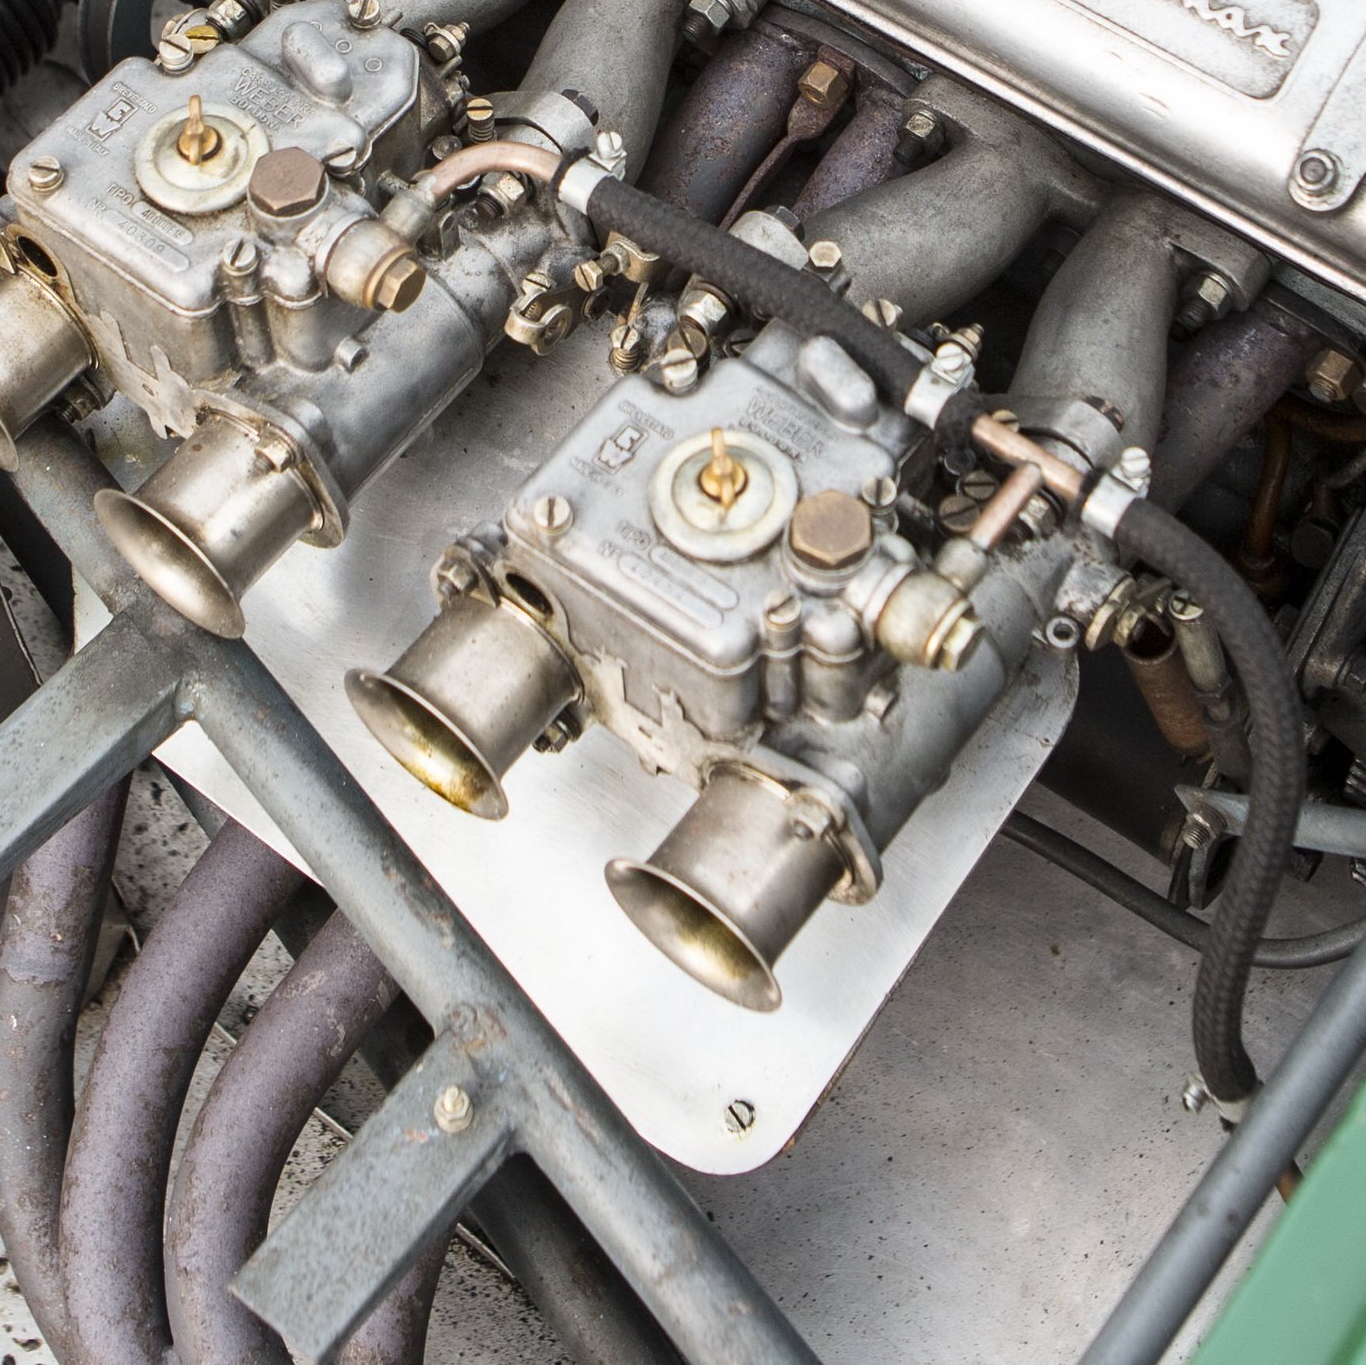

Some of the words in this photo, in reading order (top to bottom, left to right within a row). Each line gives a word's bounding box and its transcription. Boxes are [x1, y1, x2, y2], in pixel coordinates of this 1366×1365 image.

[233, 75, 307, 129] WEBER
[105, 182, 135, 205] TIPO
[745, 395, 827, 459] WEBER
